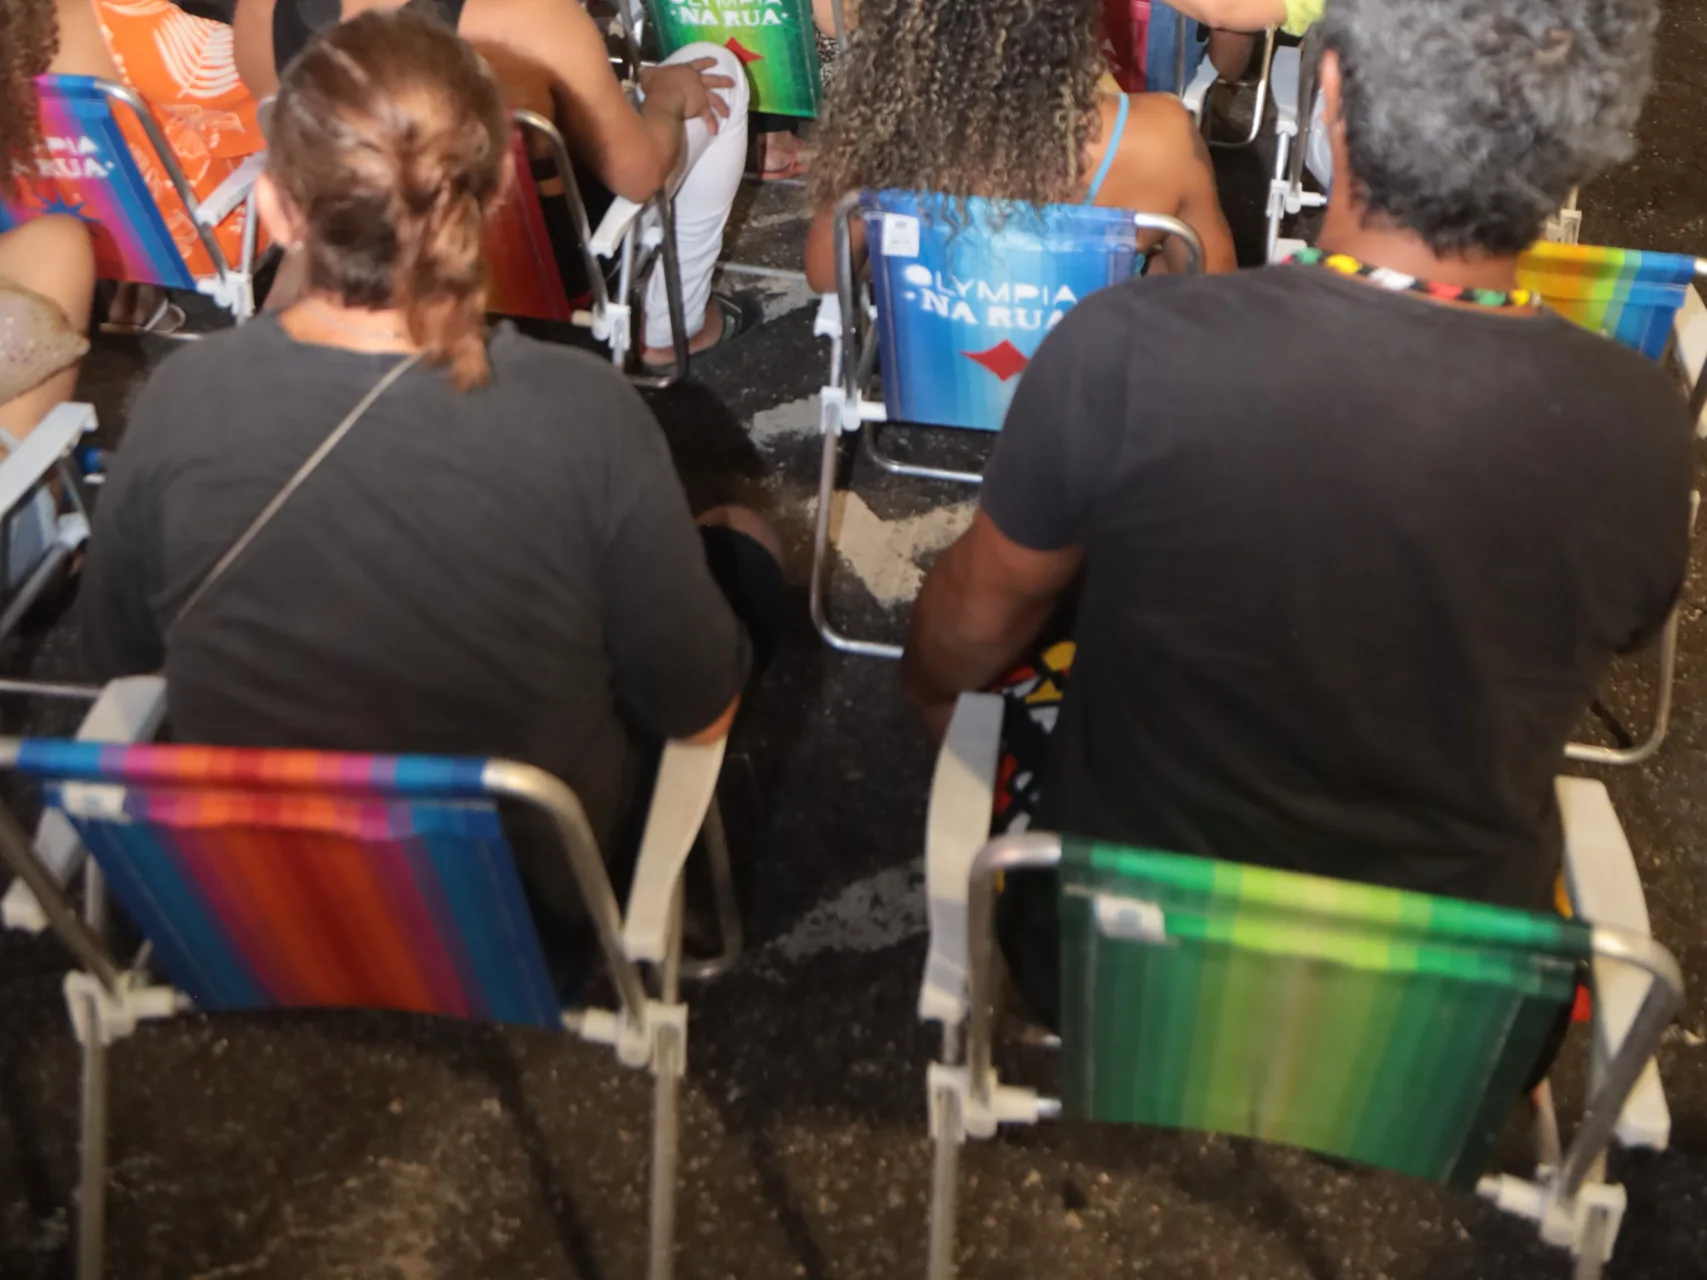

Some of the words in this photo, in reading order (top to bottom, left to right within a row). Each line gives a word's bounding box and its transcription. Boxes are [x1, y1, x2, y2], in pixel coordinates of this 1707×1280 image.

[679, 6, 719, 26] NA
[723, 8, 783, 27] RUA
[904, 264, 1078, 306] OLYMPIA
[921, 287, 978, 325] NA
